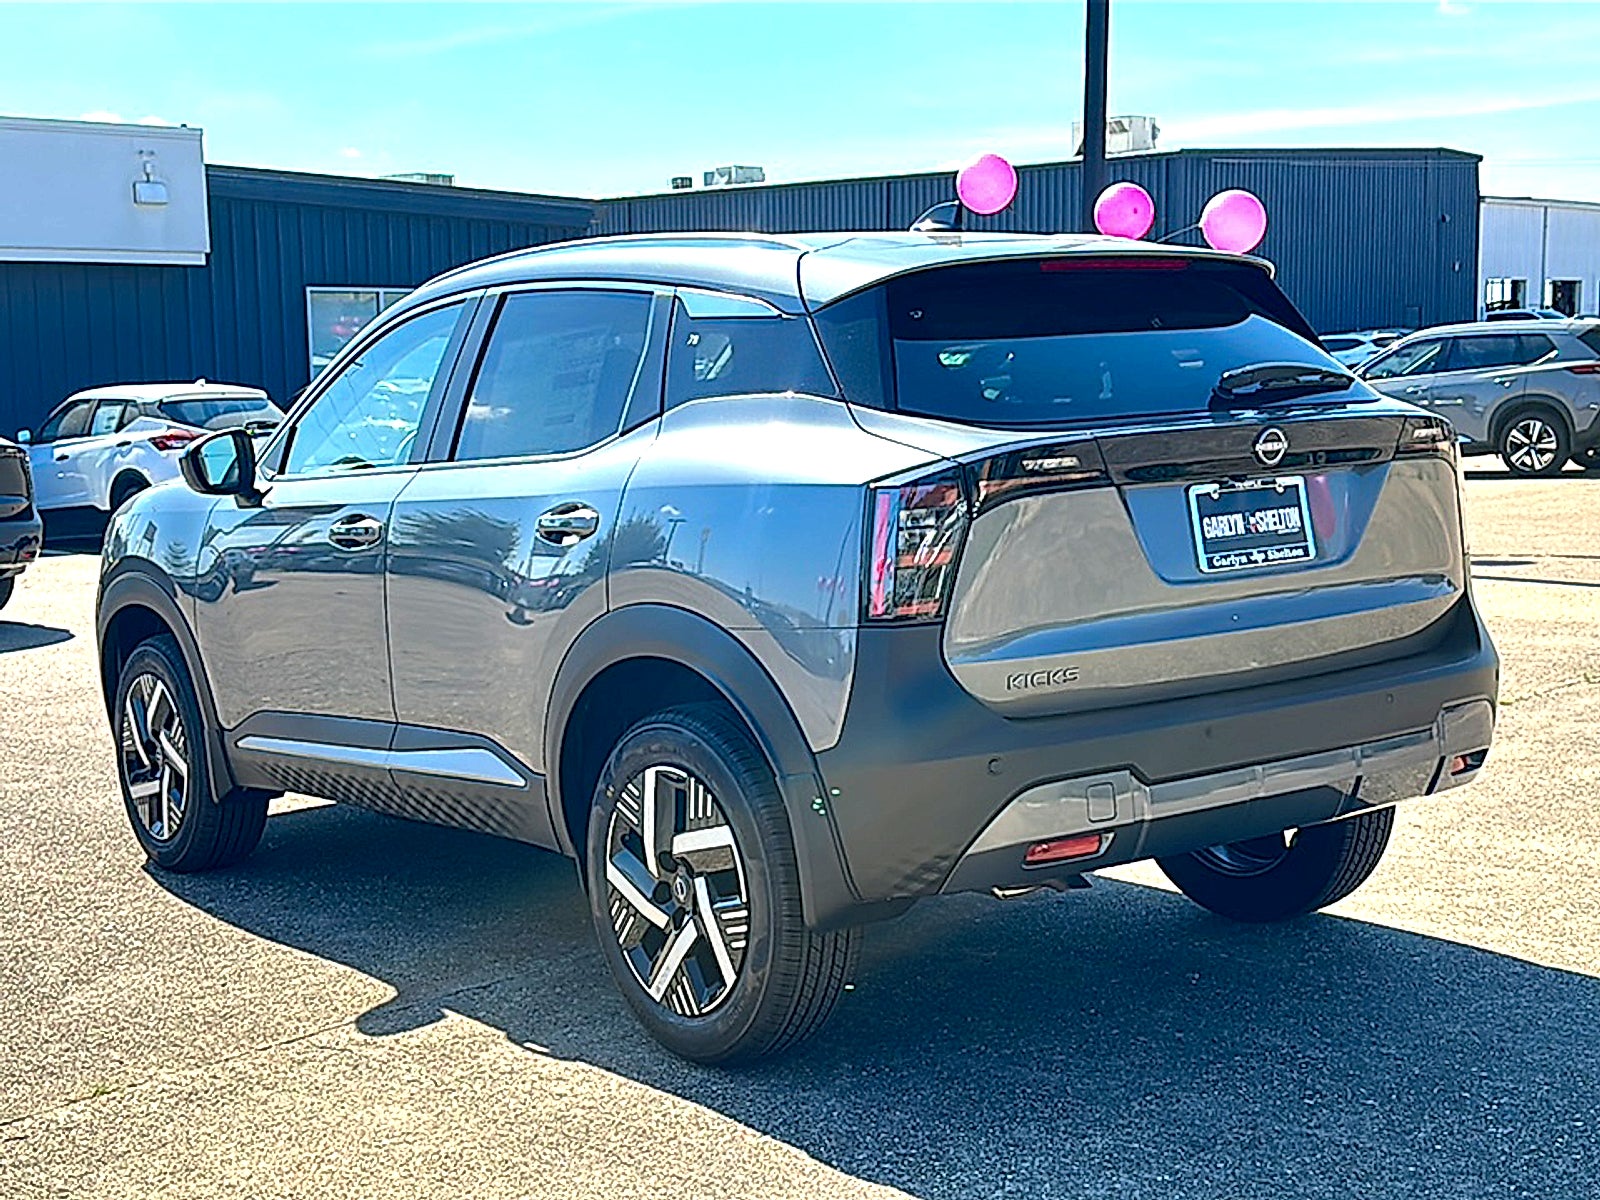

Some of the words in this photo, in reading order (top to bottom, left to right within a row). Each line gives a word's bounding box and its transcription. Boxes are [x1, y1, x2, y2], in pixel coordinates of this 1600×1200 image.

[1203, 513, 1246, 538] GARLYN
[1255, 507, 1301, 532] SHELTON
[1006, 666, 1079, 690] KICKS
